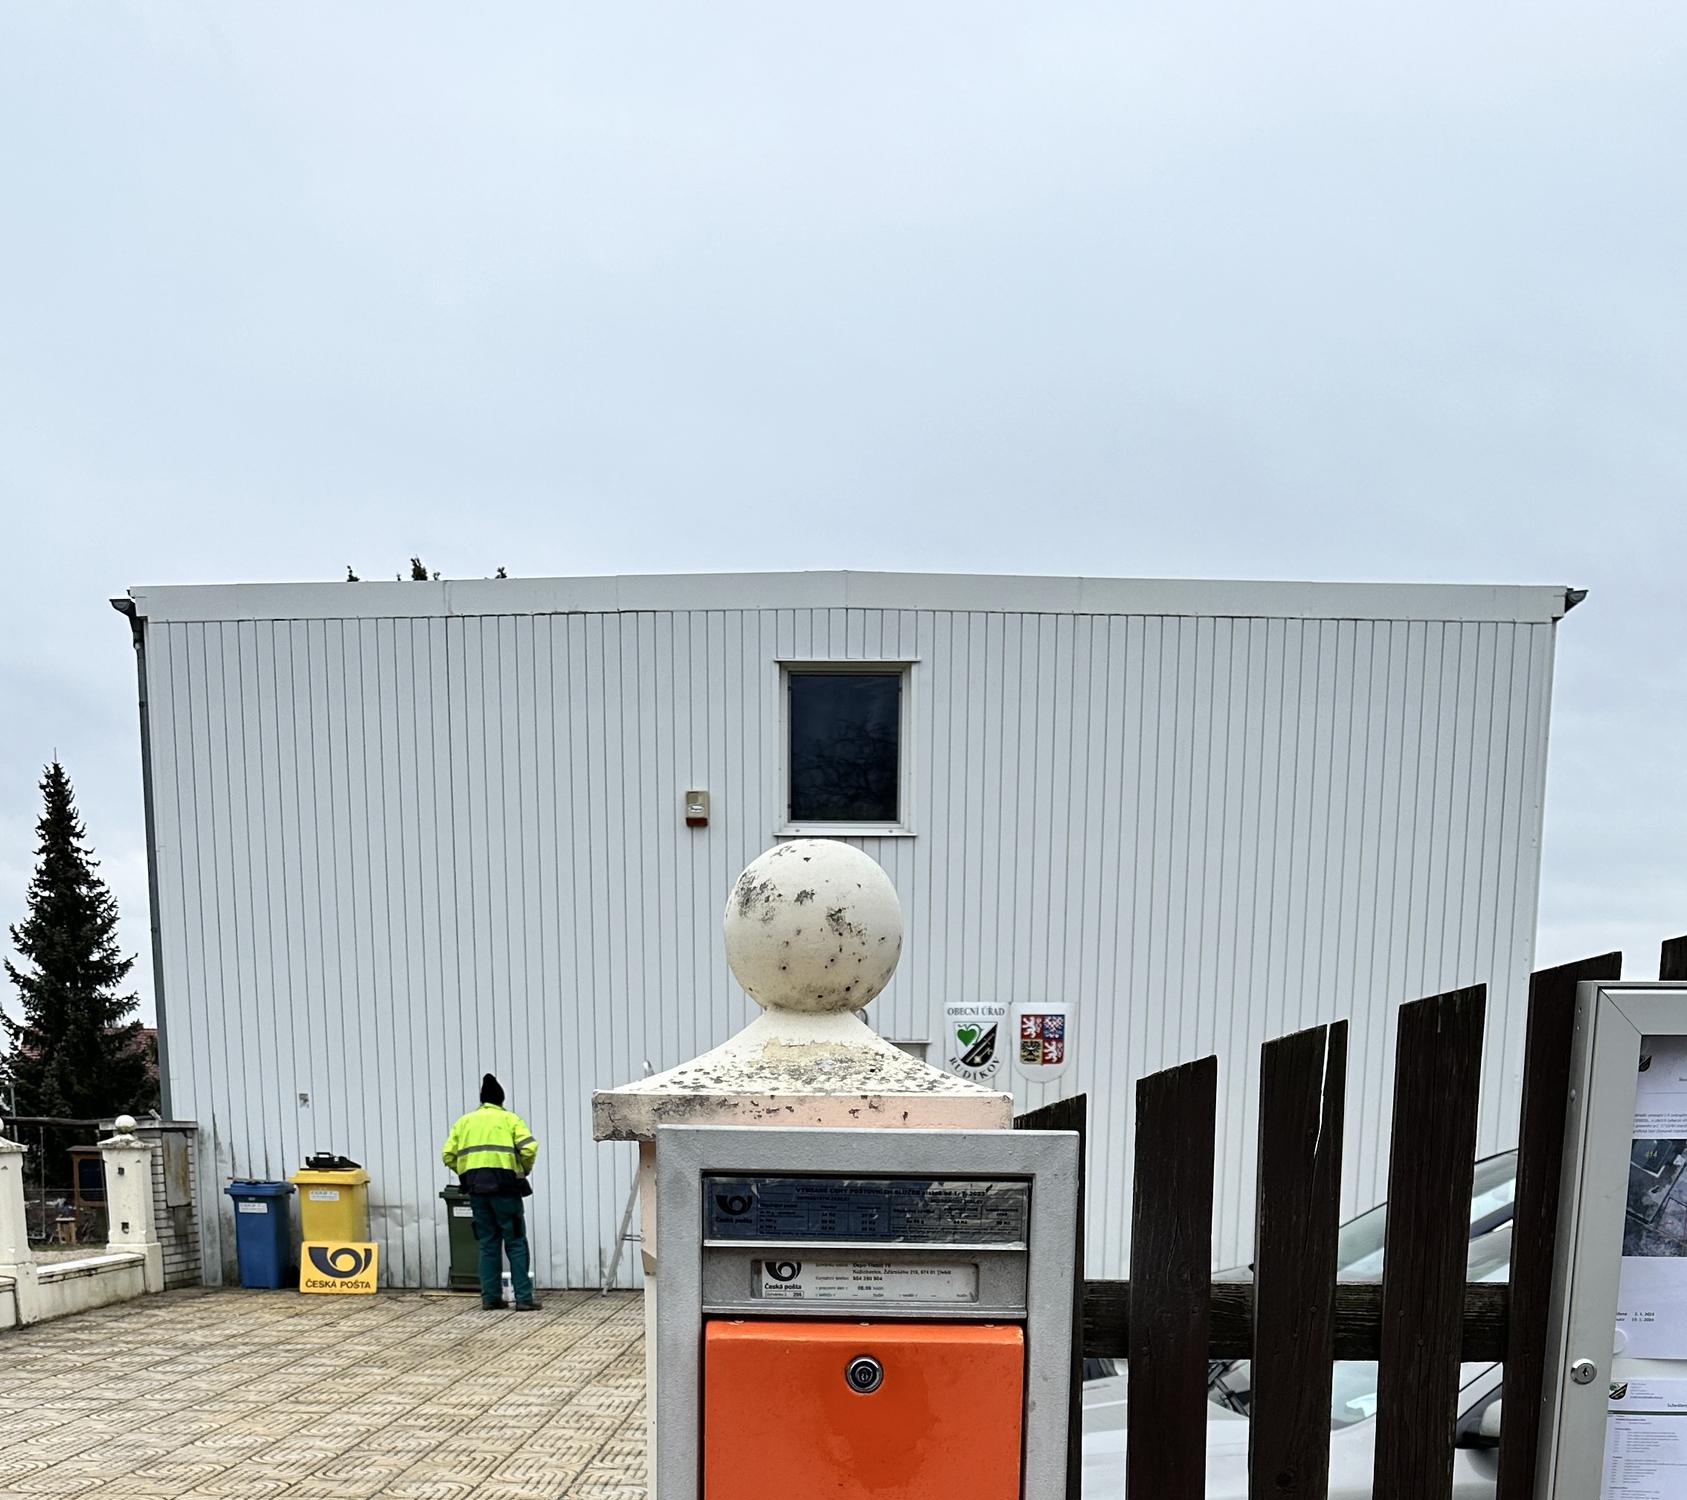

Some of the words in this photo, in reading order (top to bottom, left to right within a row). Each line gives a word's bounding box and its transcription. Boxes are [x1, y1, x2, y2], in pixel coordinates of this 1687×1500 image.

[947, 1007, 979, 1016] OBECNÍ
[982, 1007, 1005, 1016] ÚŘAD
[949, 1056, 1001, 1080] RUDÍKOV
[305, 1277, 336, 1289] ČESKÁ
[340, 1278, 371, 1290] POŠTA
[764, 1282, 783, 1290] Česká
[784, 1283, 802, 1291] pošta
